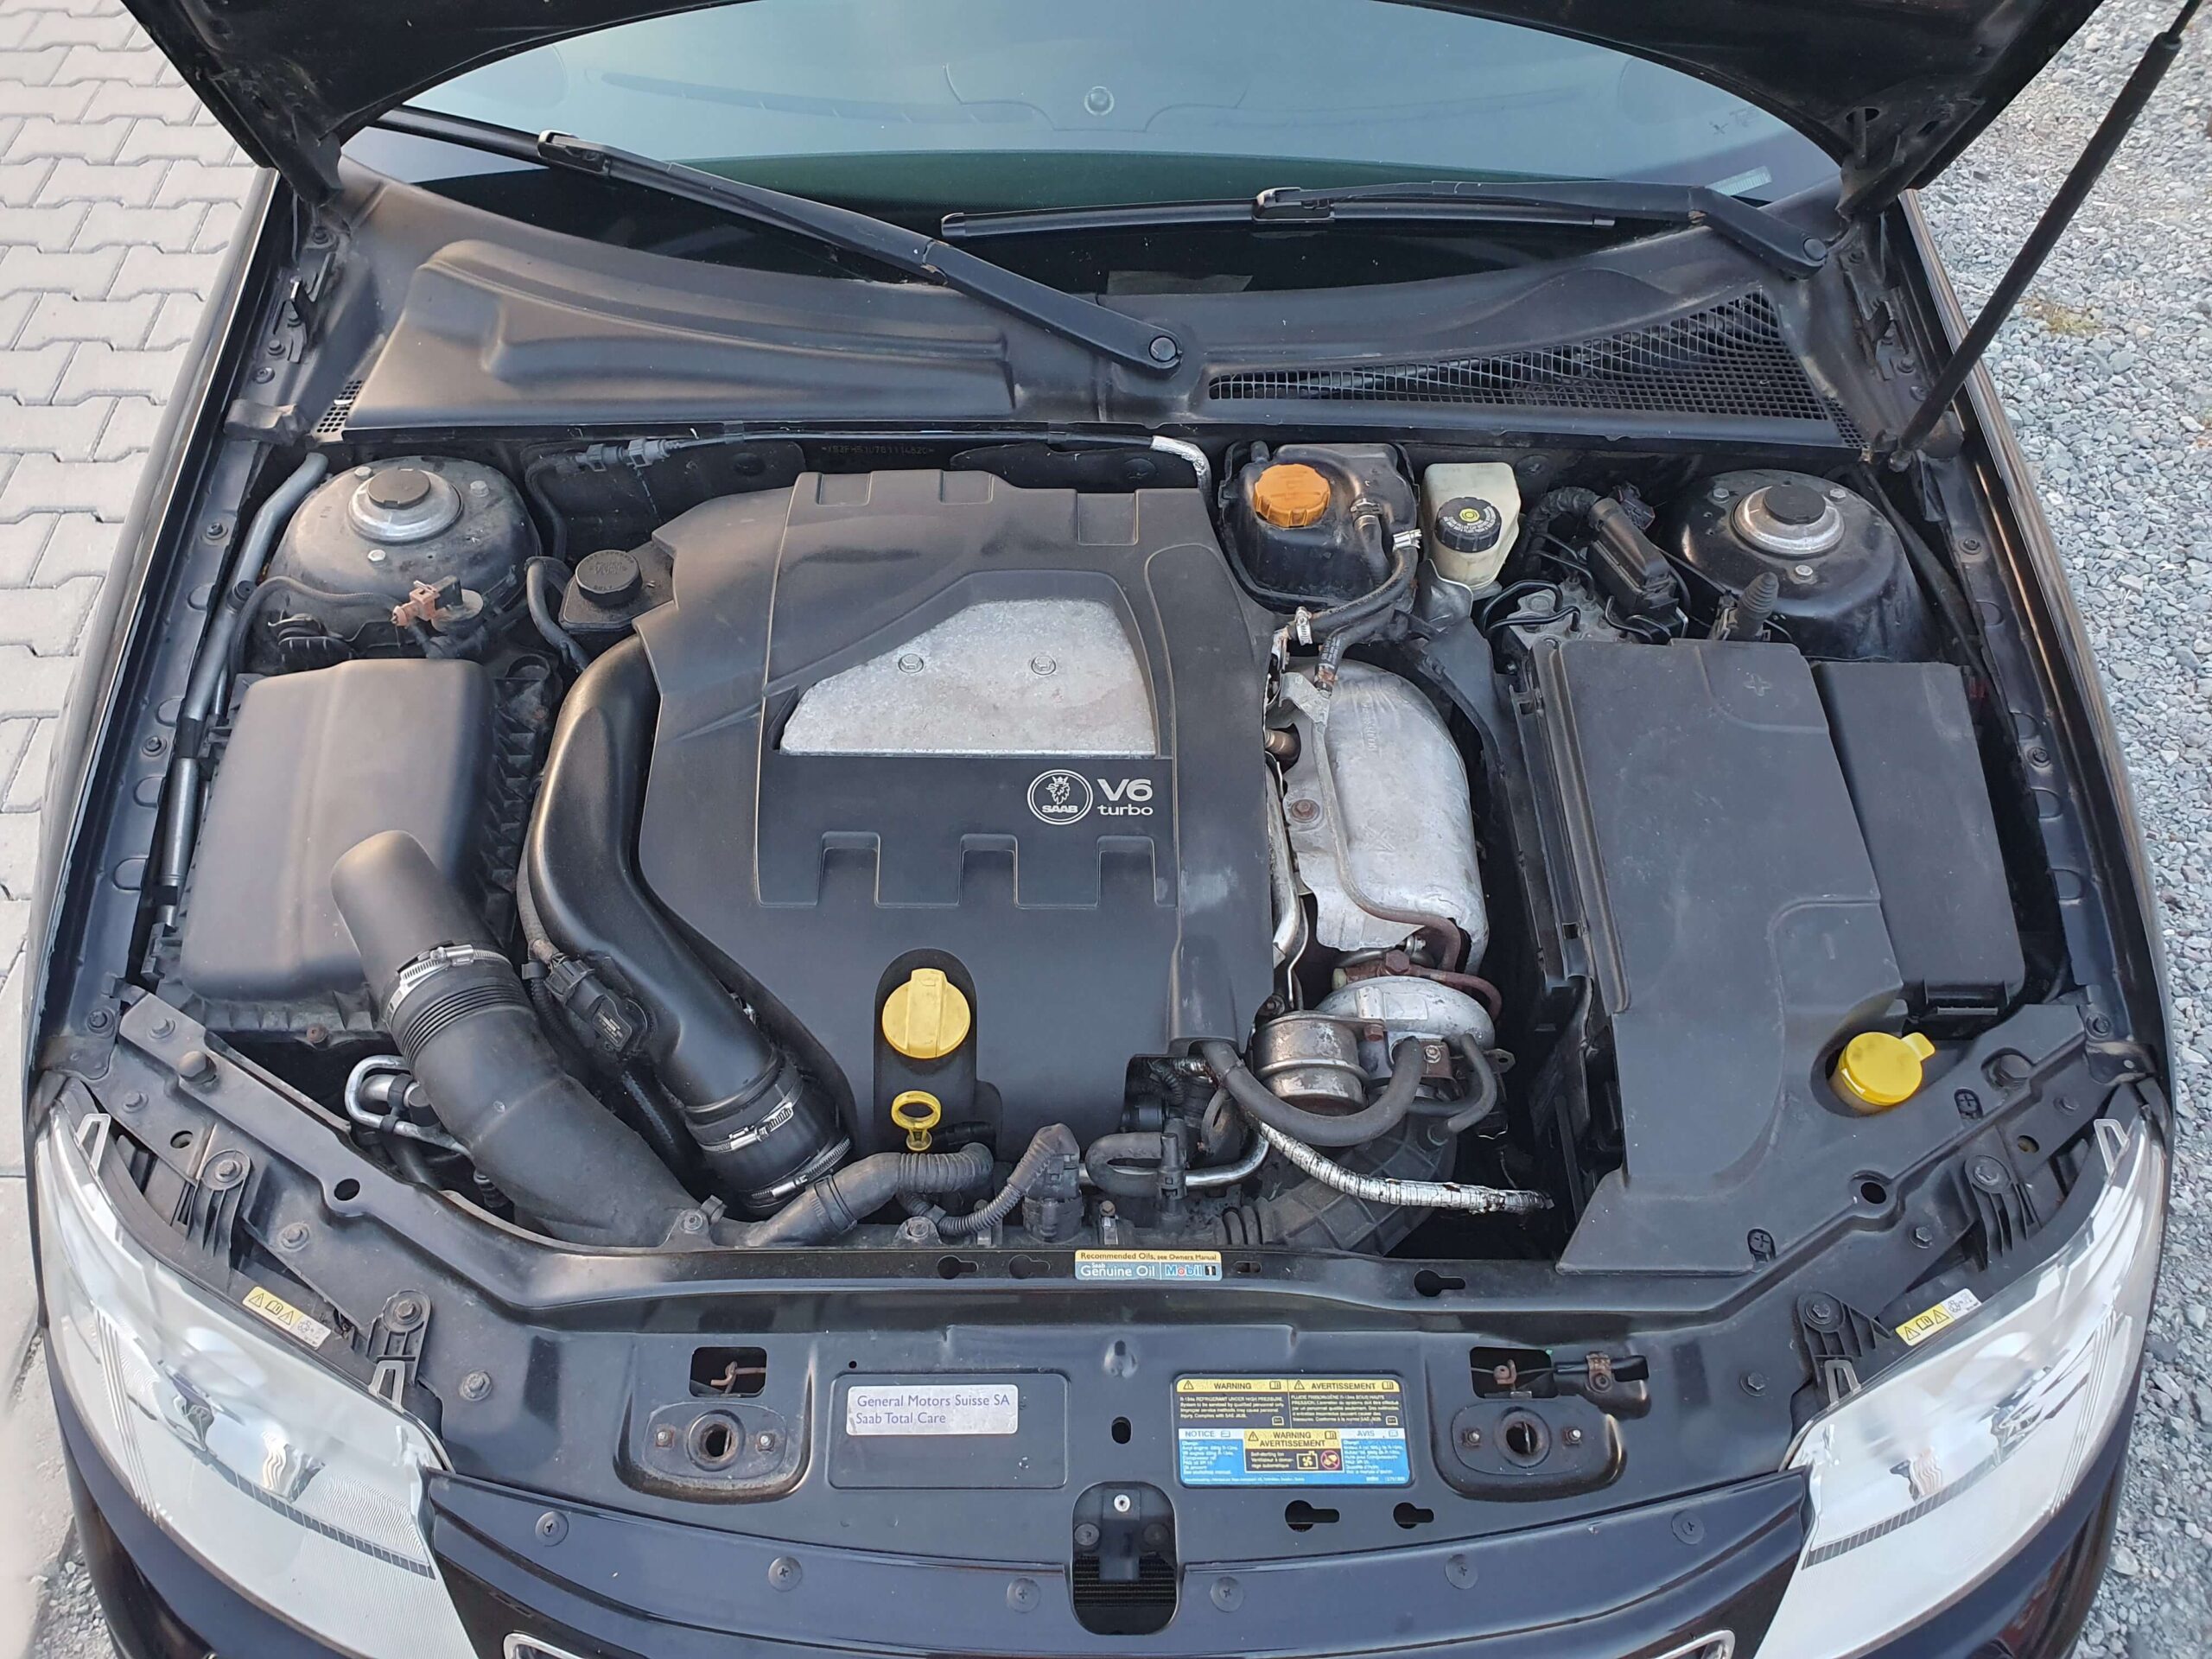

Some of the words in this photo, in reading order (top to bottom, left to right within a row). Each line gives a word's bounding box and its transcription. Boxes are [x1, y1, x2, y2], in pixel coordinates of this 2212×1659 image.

[1097, 779, 1154, 802] V6
[1097, 804, 1154, 816] turbo
[1080, 1265, 1132, 1275] Genuine
[1136, 1265, 1154, 1275] Oil
[1165, 1264, 1203, 1276] Mobil
[857, 1395, 904, 1407] General
[908, 1395, 950, 1407] Motors
[956, 1395, 989, 1407] Suisse
[994, 1394, 1010, 1406] SA
[856, 1412, 881, 1424] Saab
[885, 1412, 912, 1424] Total
[918, 1412, 946, 1424] Care
